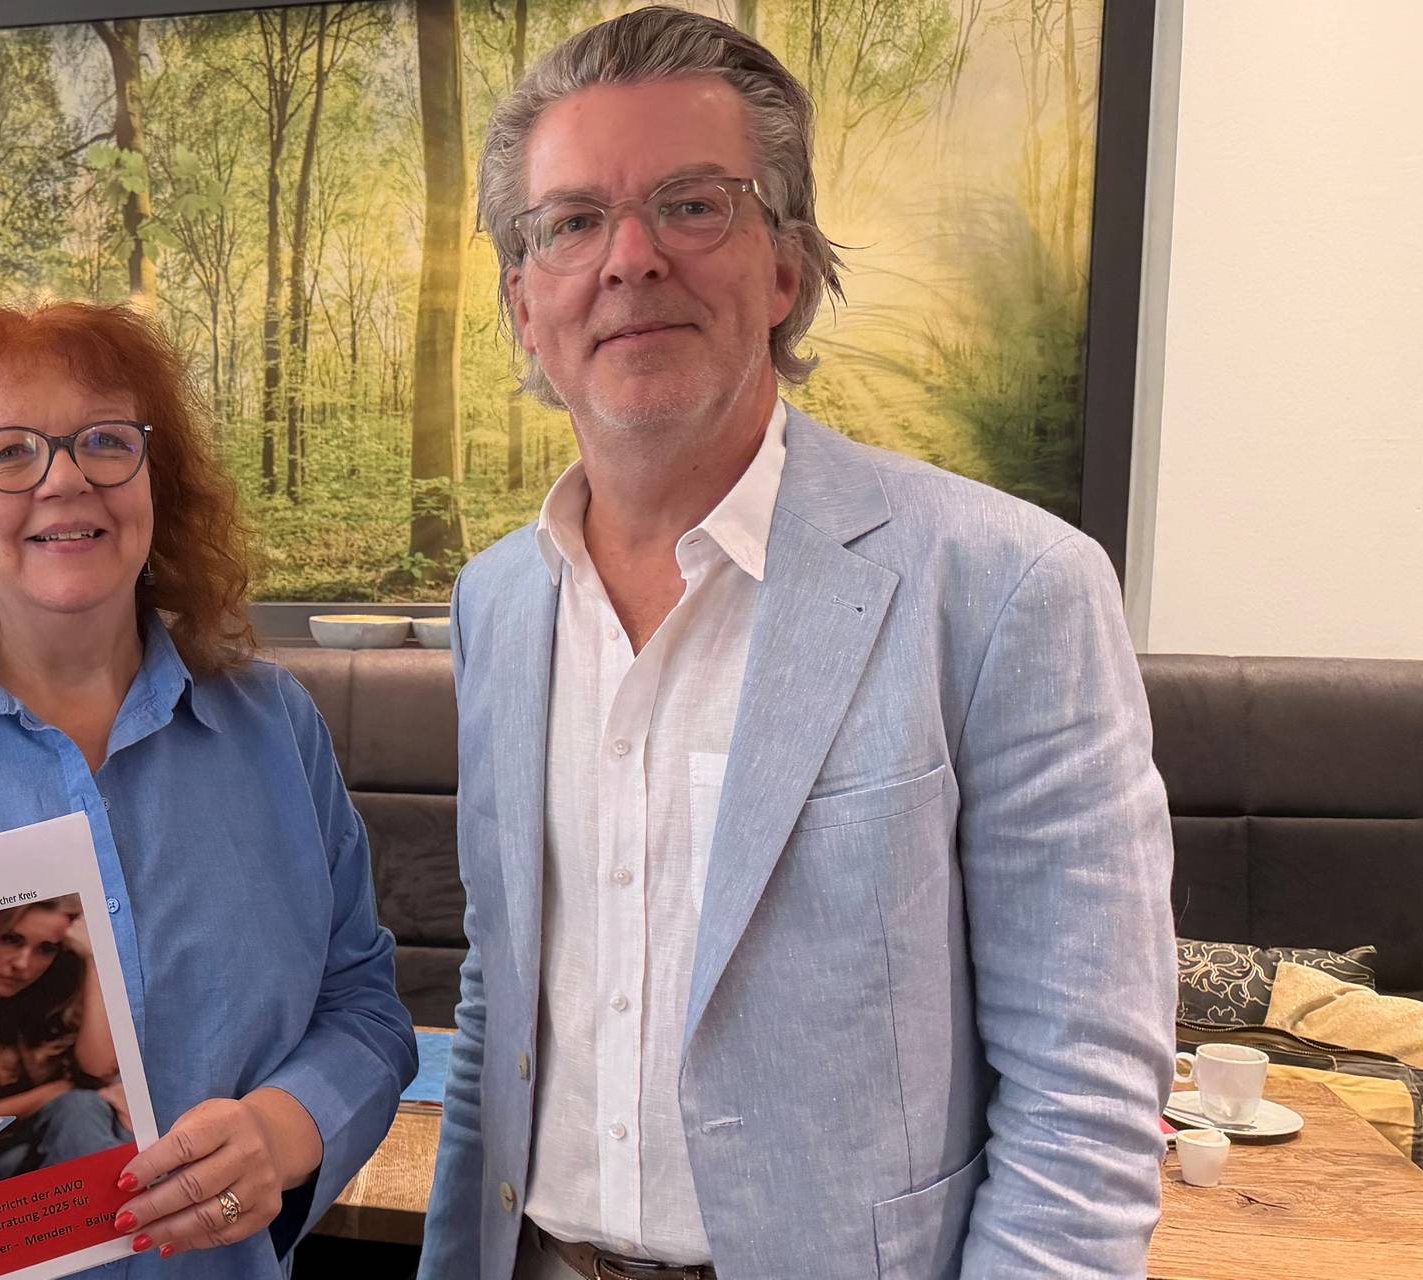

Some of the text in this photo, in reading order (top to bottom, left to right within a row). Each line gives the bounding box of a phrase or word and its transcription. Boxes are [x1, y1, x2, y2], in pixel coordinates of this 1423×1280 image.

[18, 890, 38, 901] Kreis
[31, 1190, 51, 1204] der
[54, 1179, 84, 1197] AWO
[42, 1202, 70, 1217] 2025
[73, 1196, 89, 1207] für
[25, 1223, 73, 1246] Menden
[85, 1211, 117, 1227] Balve
